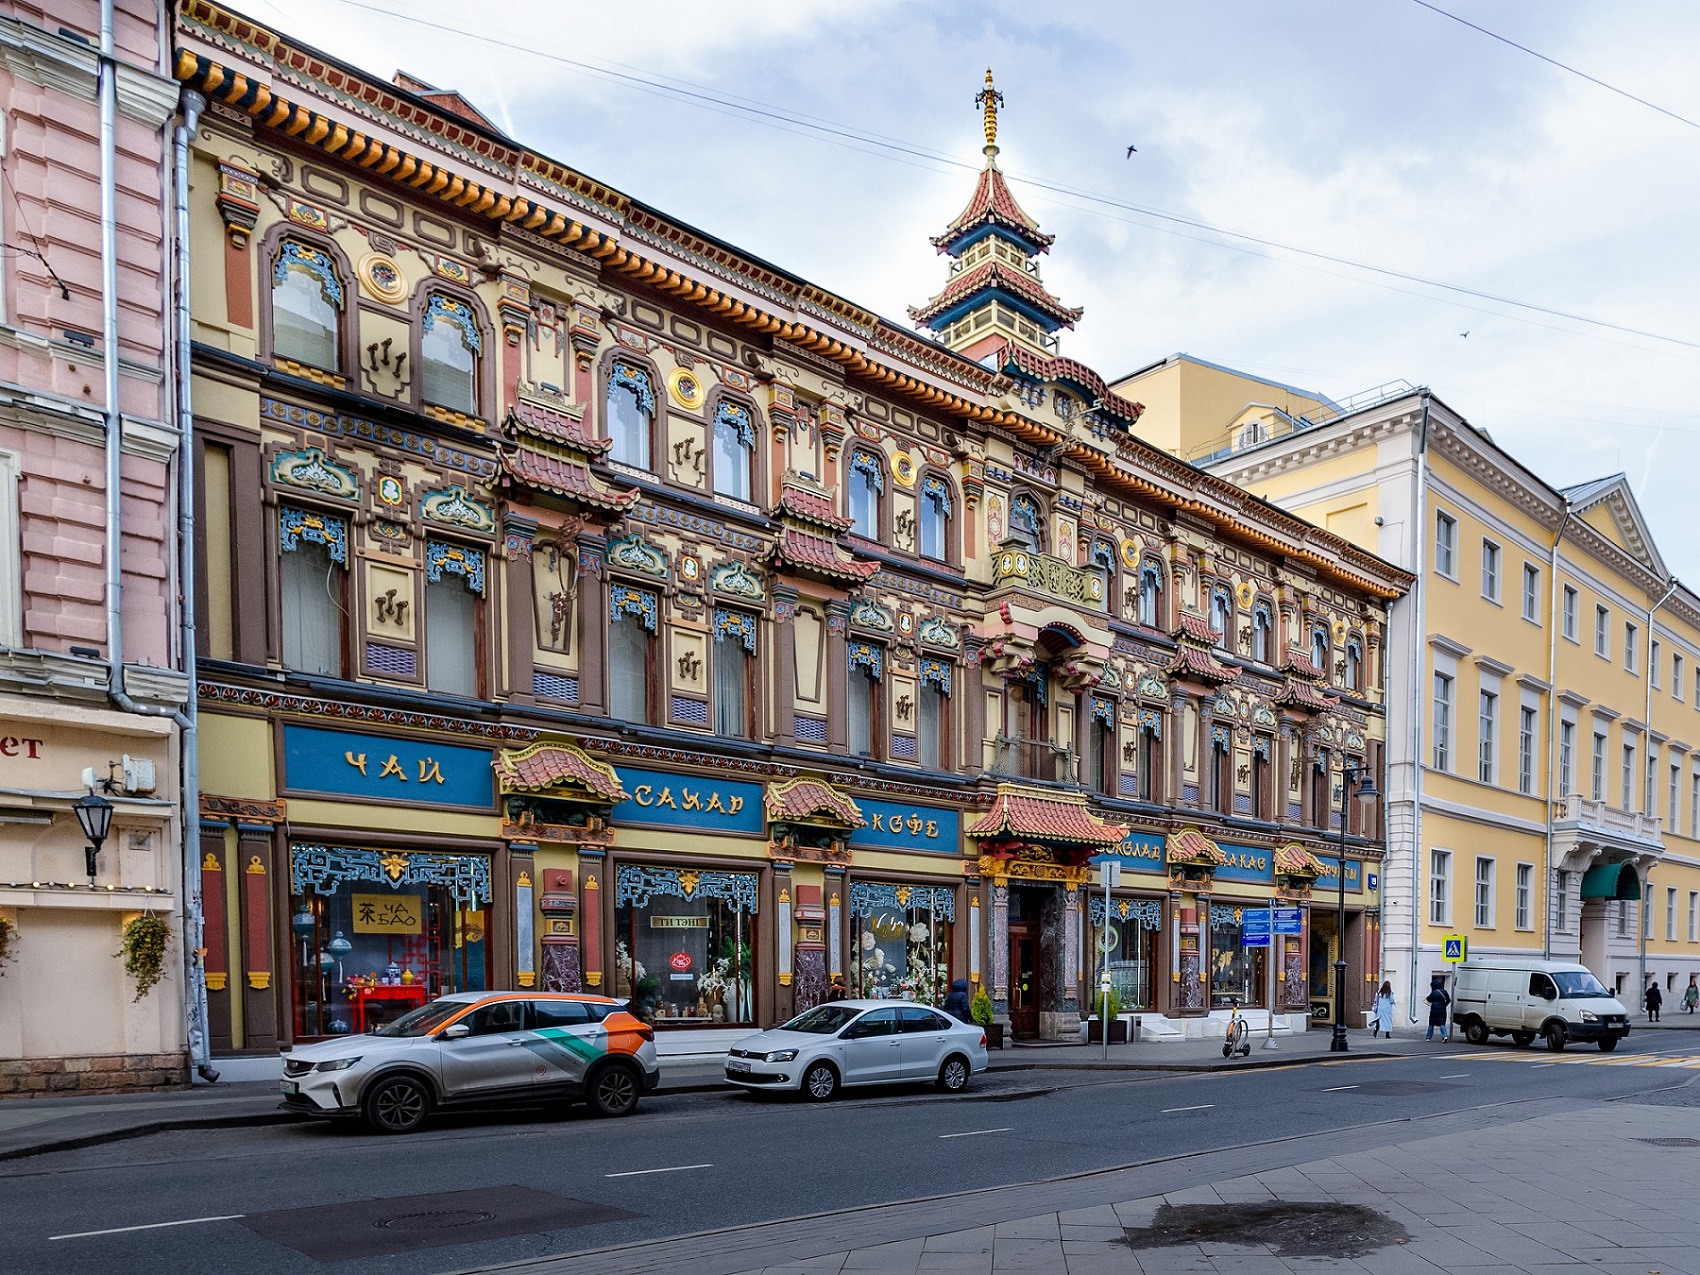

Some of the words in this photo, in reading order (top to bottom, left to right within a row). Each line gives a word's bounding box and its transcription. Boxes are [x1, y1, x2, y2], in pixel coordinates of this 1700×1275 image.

[344, 751, 445, 784] ЧАЙ
[634, 784, 744, 815] САХАР
[872, 812, 939, 838] КОФЕ
[1222, 853, 1266, 871] АКАО
[359, 902, 376, 925] 茶
[377, 913, 416, 926] БАО
[384, 903, 408, 914] ЧА
